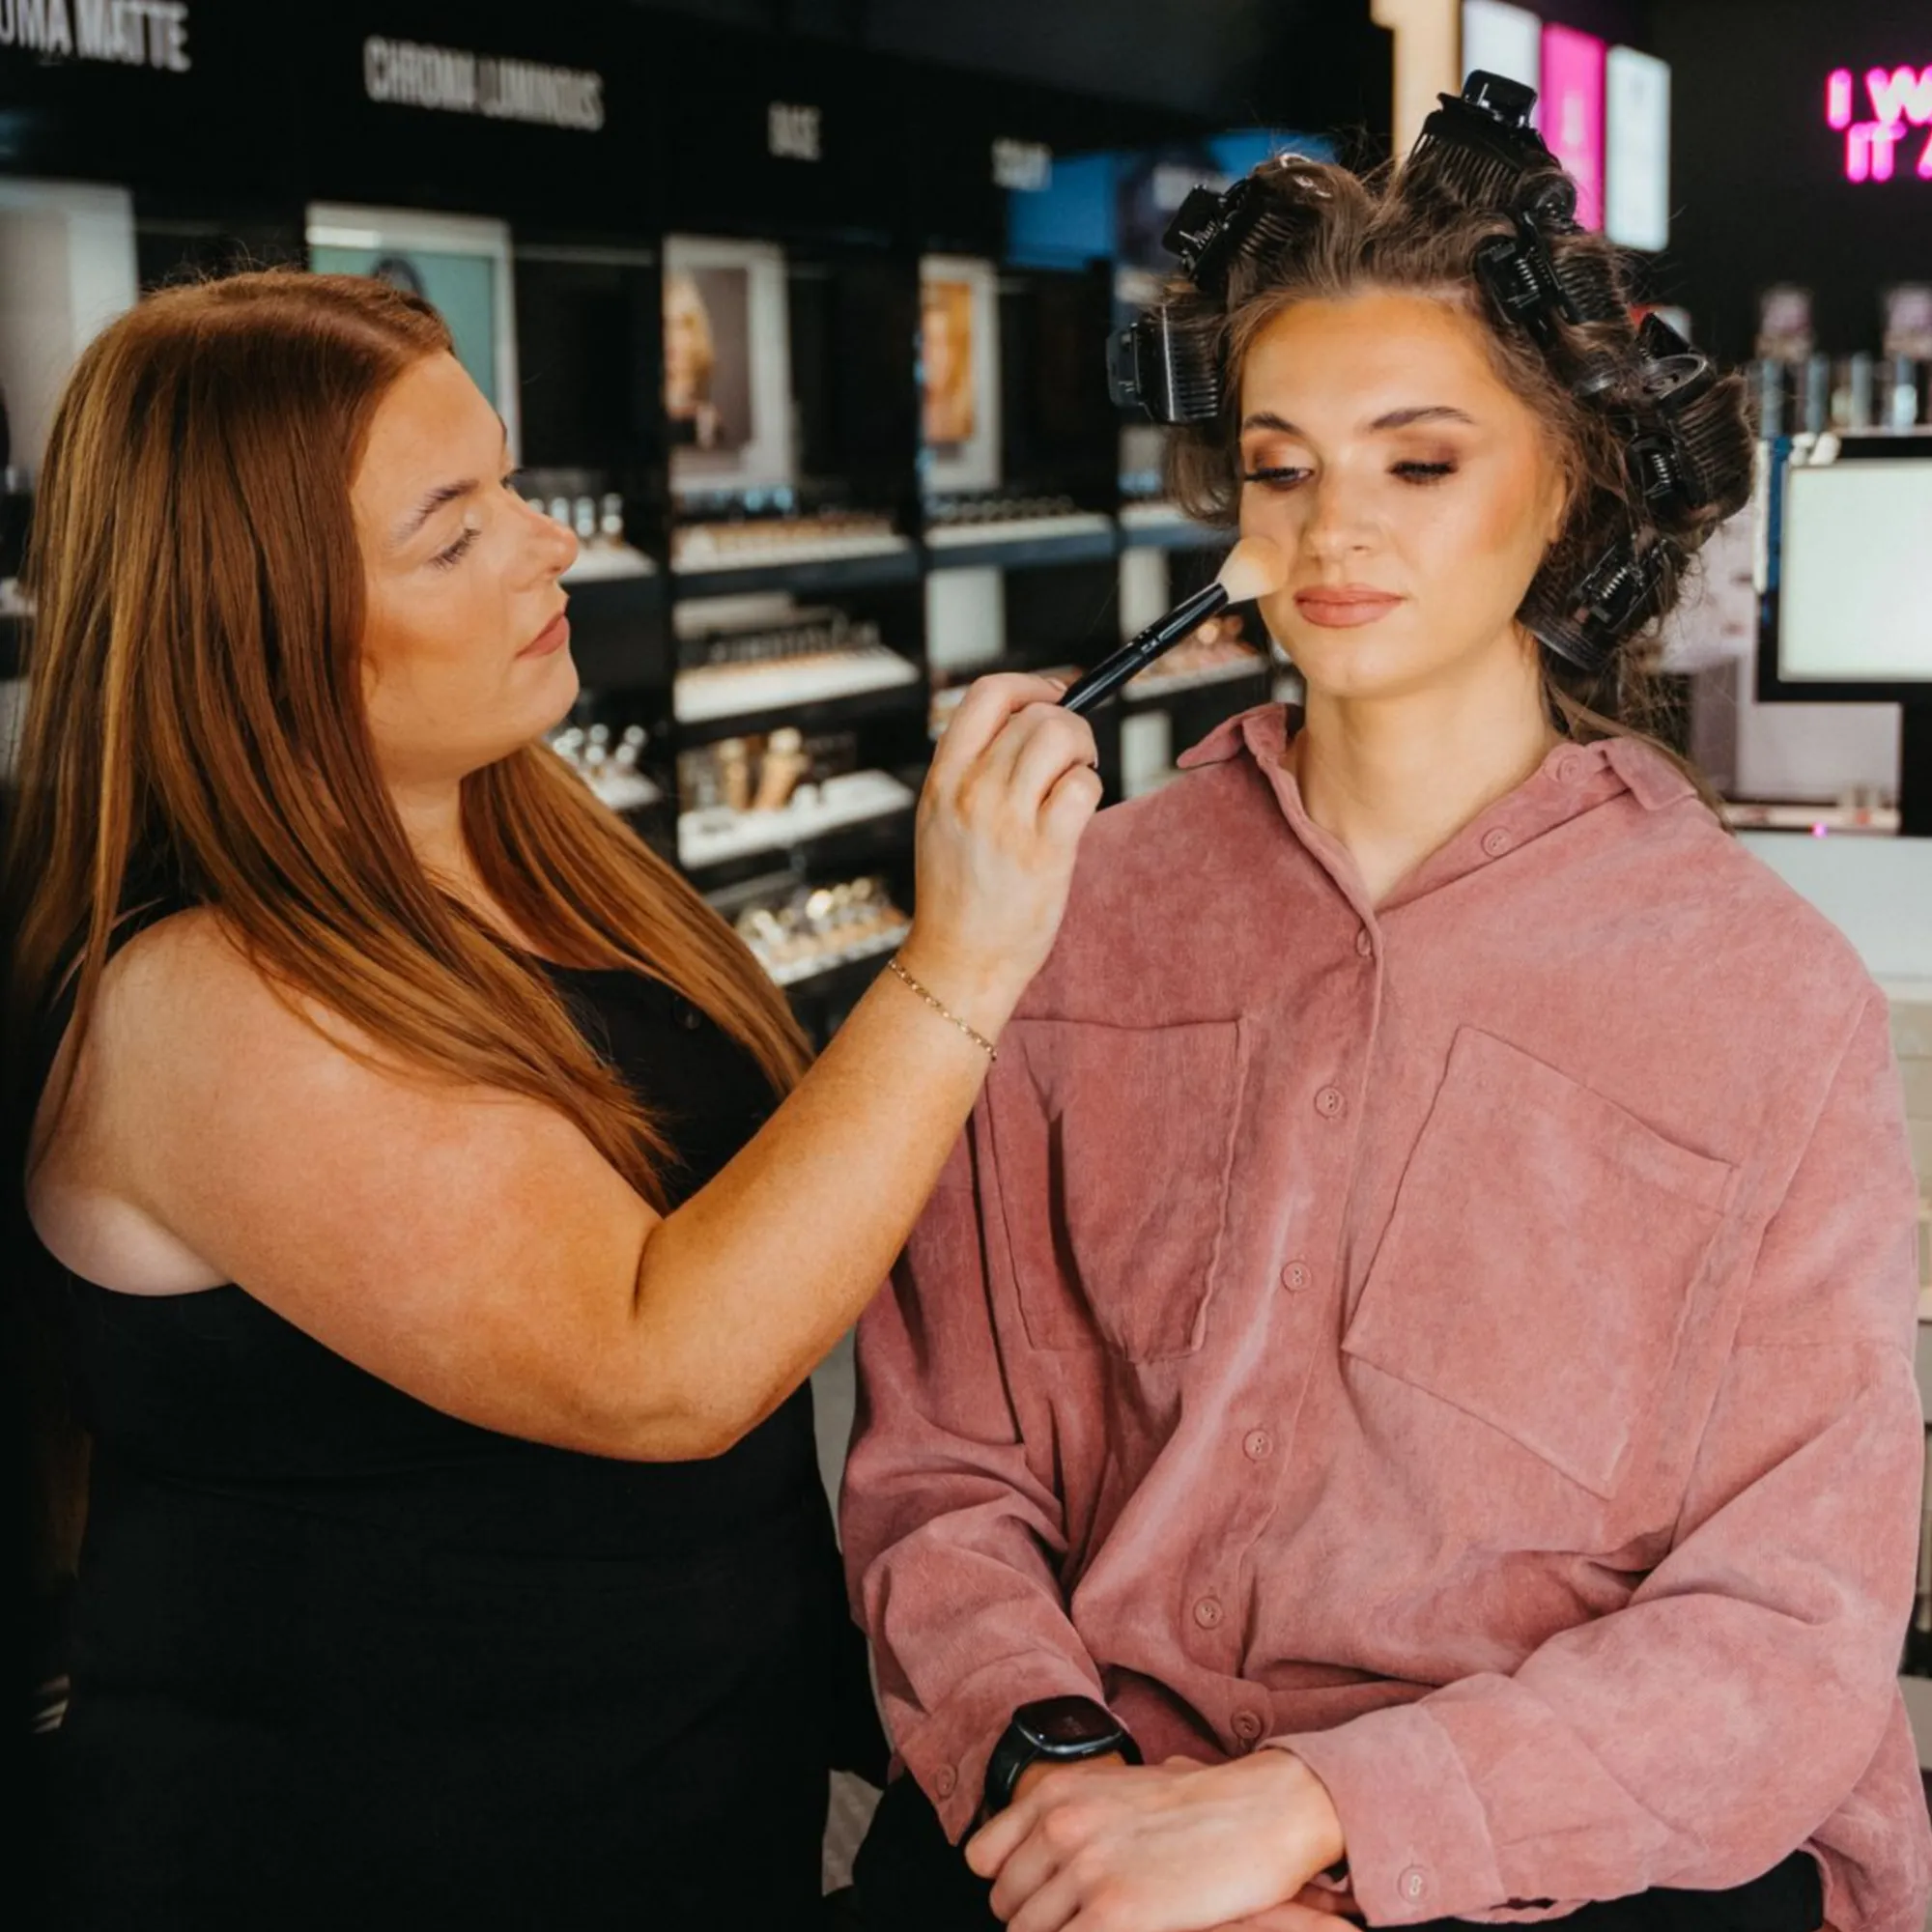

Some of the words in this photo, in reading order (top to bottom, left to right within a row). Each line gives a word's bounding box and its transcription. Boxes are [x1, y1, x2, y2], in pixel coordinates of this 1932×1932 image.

[75, 0, 191, 72] MATTE
[364, 35, 475, 113] CHROMA
[477, 56, 605, 131] LUMINOUS
[1826, 66, 1853, 132] I
[1844, 120, 1908, 184] IT
